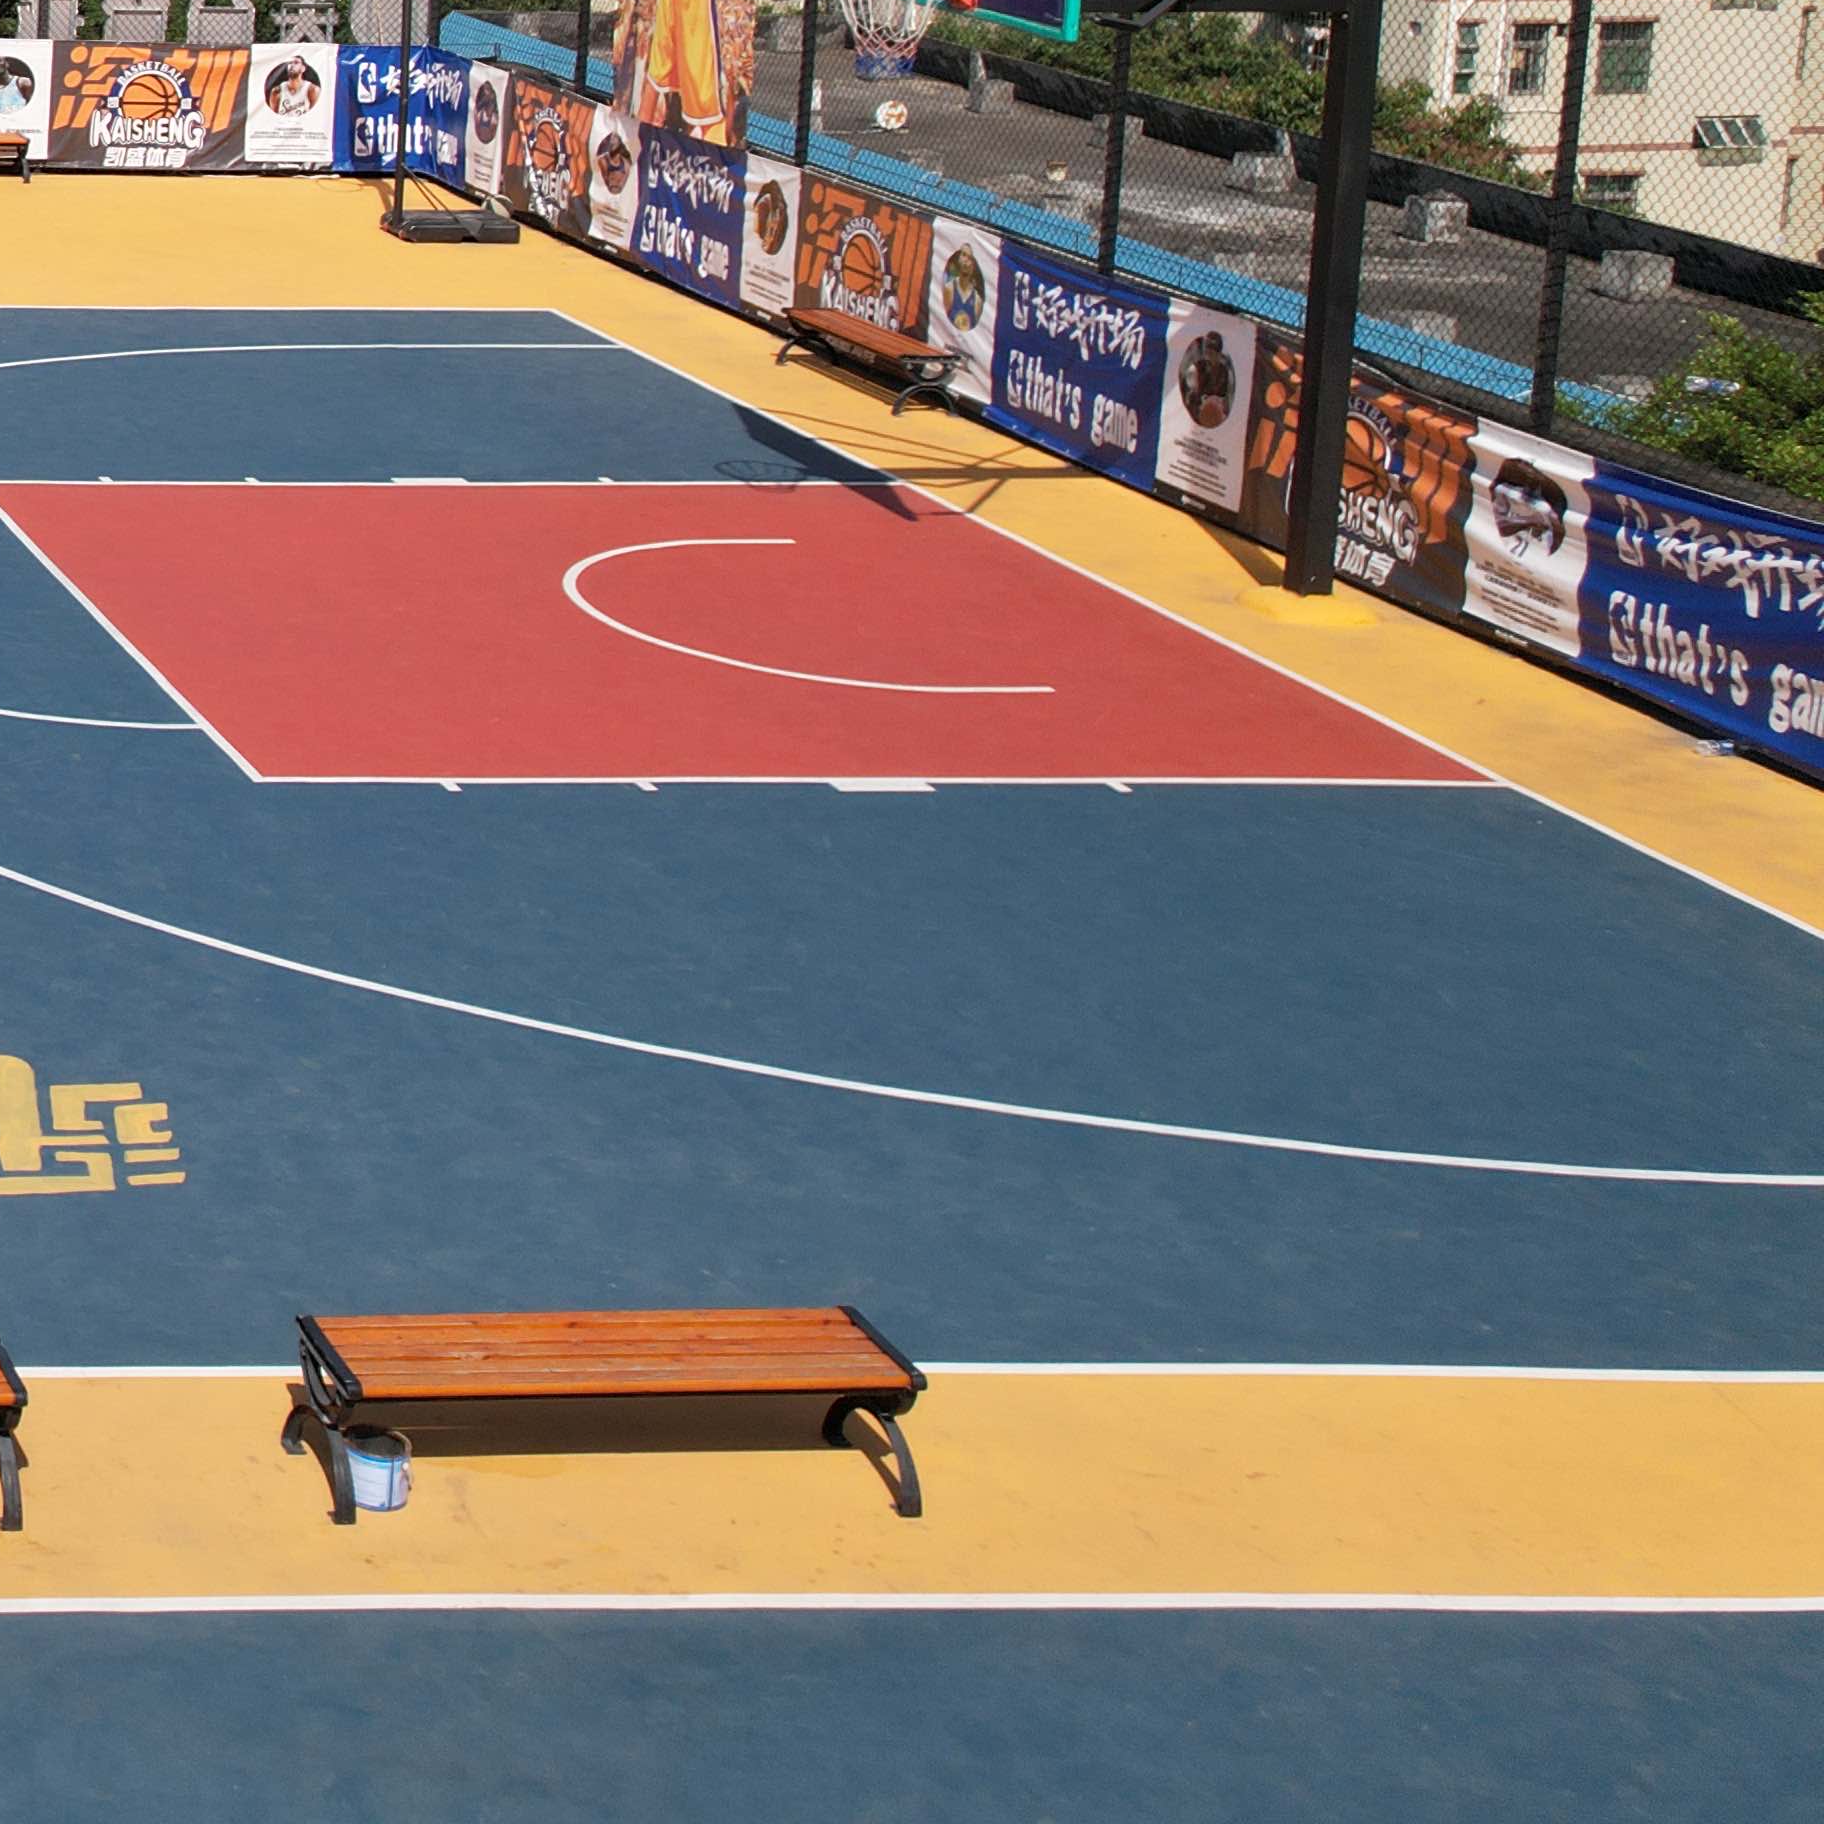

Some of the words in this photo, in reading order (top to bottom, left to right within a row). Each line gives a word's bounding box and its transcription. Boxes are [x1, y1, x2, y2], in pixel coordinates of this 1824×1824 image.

[117, 60, 186, 85] BASKETBALL
[89, 109, 206, 150] KAISHENG
[103, 146, 188, 168] 凯盛体育
[820, 269, 901, 332] KAISHENG
[1025, 355, 1082, 431] that's
[1090, 393, 1139, 454] game
[1639, 602, 1749, 707] that's
